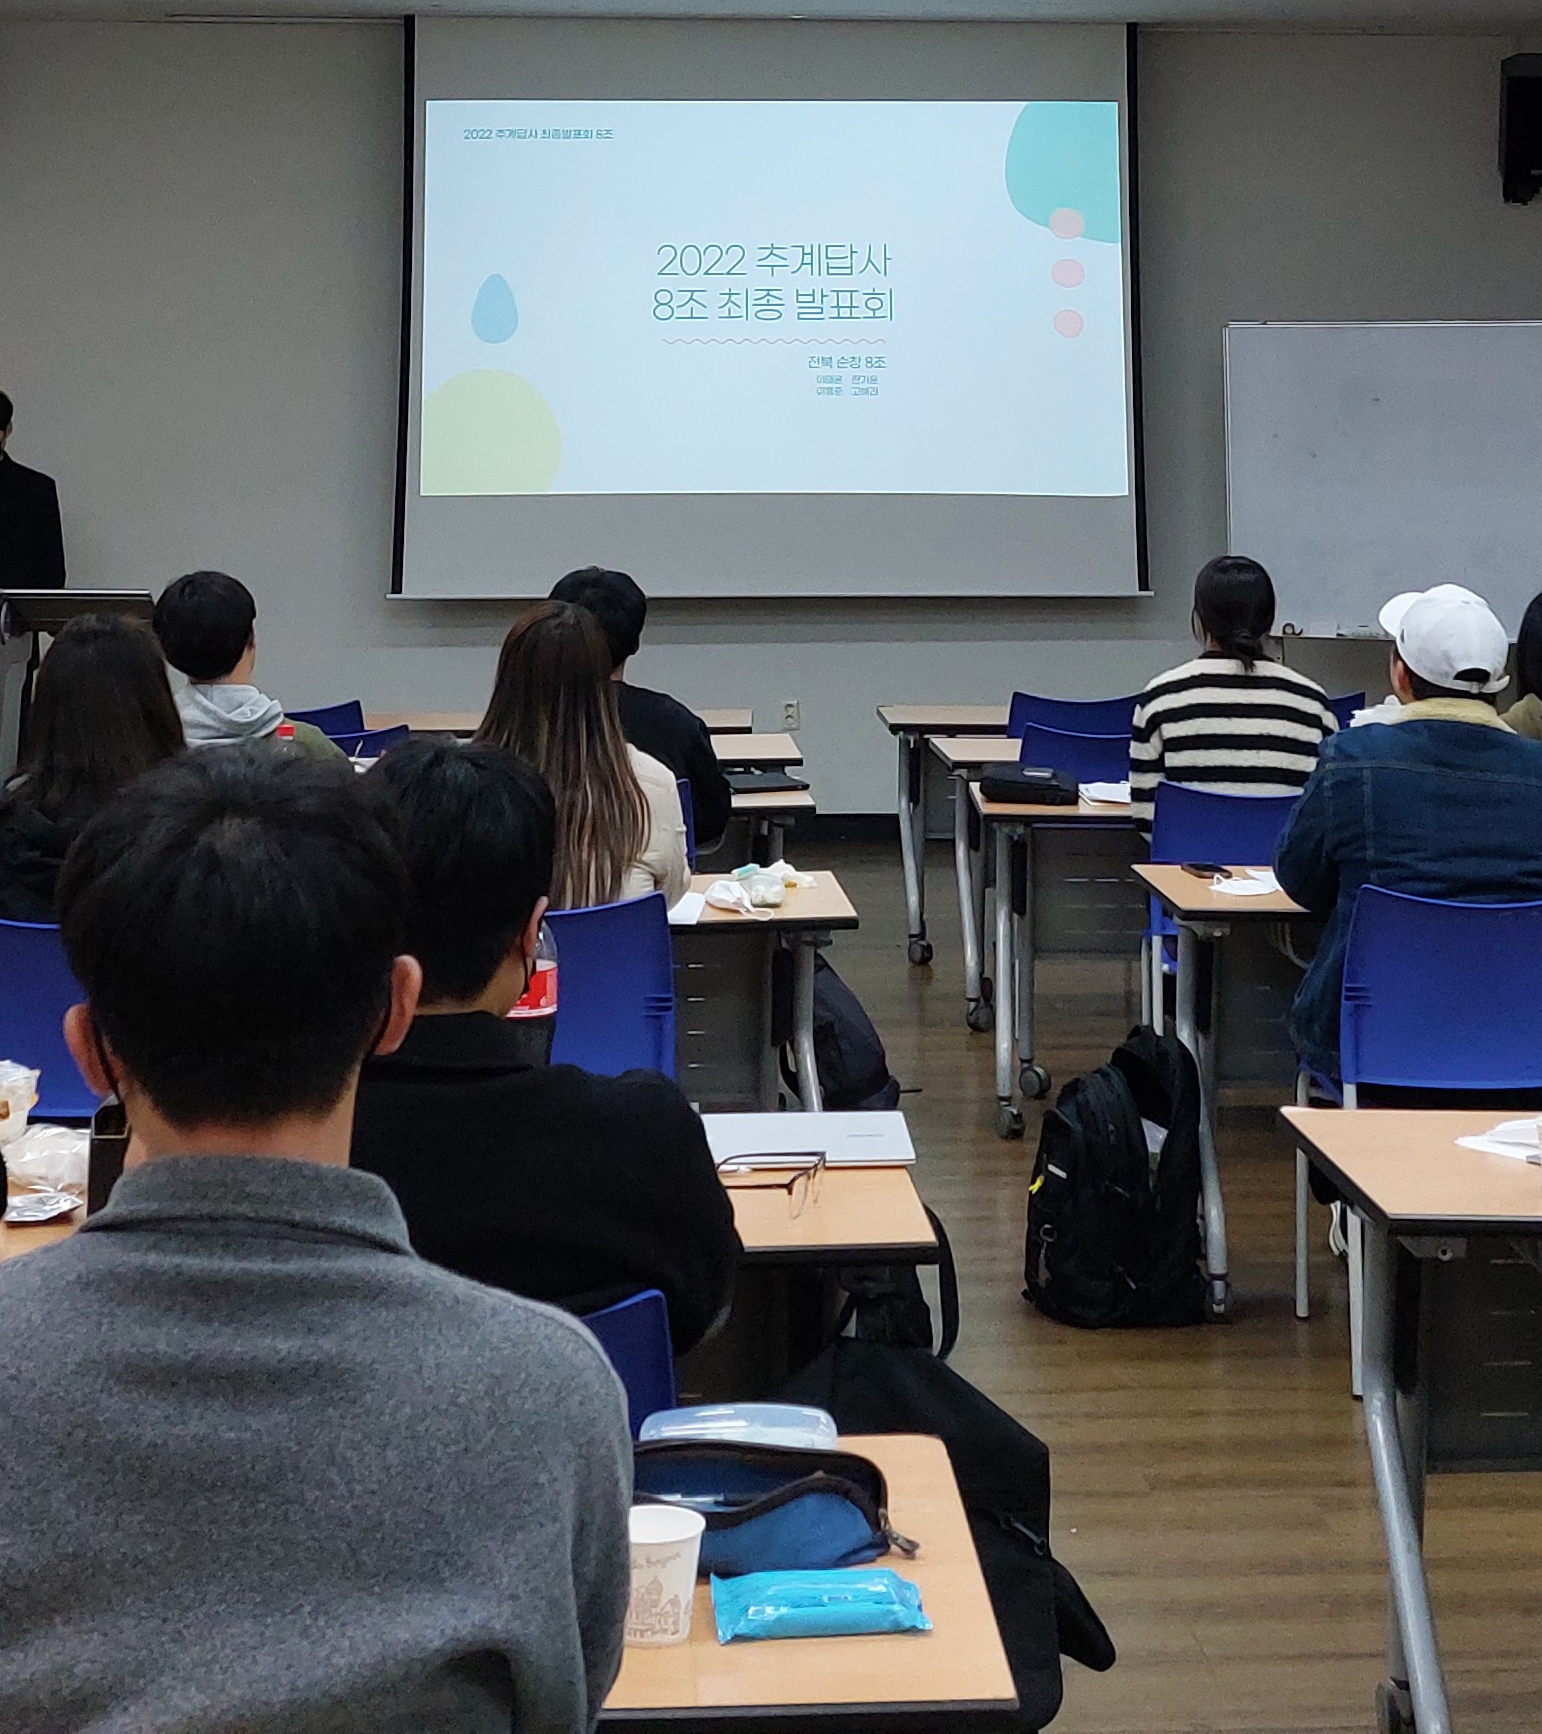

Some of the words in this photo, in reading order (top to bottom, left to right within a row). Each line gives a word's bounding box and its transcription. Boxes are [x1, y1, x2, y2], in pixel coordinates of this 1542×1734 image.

[463, 128, 493, 140] 2022
[495, 127, 538, 140] 추계답사
[595, 129, 614, 140] 8조
[656, 243, 748, 276] 2022
[755, 242, 892, 278] 추계답사
[652, 287, 709, 321] 8조
[717, 286, 786, 321] 최종
[794, 286, 894, 321] 발표회
[808, 355, 833, 369] 전북
[836, 355, 861, 369] 순창
[865, 355, 887, 369] 8조
